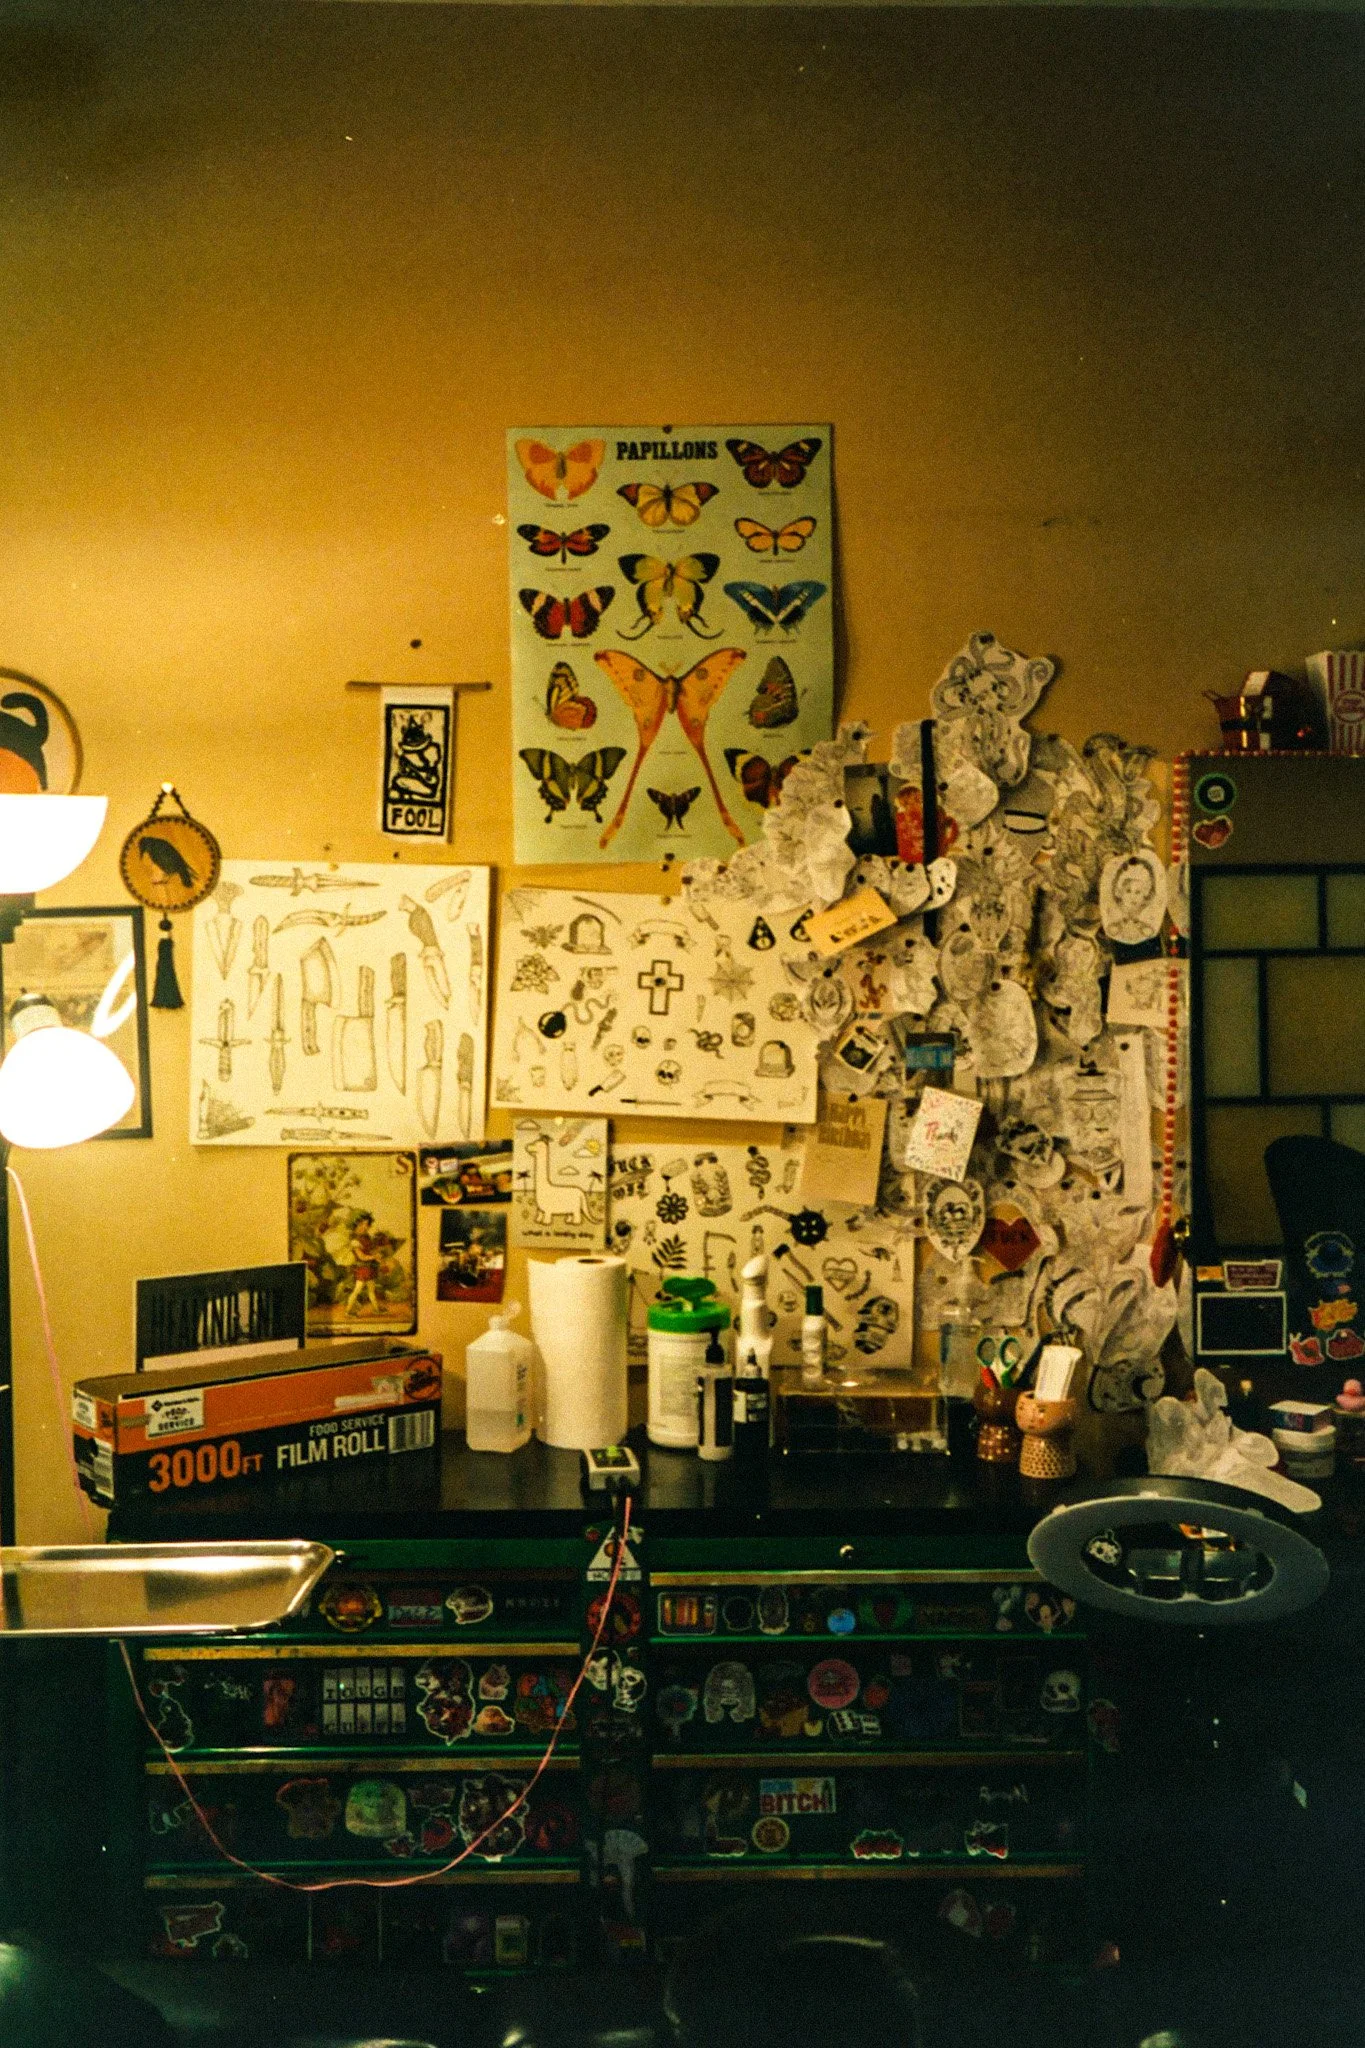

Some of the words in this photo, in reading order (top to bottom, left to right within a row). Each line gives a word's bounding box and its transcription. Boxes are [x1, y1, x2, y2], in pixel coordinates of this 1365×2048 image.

[616, 440, 719, 461] PAPILLONS
[391, 807, 440, 828] FOOL
[309, 1419, 339, 1438] FOOD
[341, 1413, 387, 1433] SERVICE
[276, 1439, 329, 1469] FILM
[333, 1429, 386, 1459] ROLL
[148, 1440, 242, 1493] 3000
[242, 1454, 264, 1475] FT
[762, 1791, 826, 1813] BITCH
